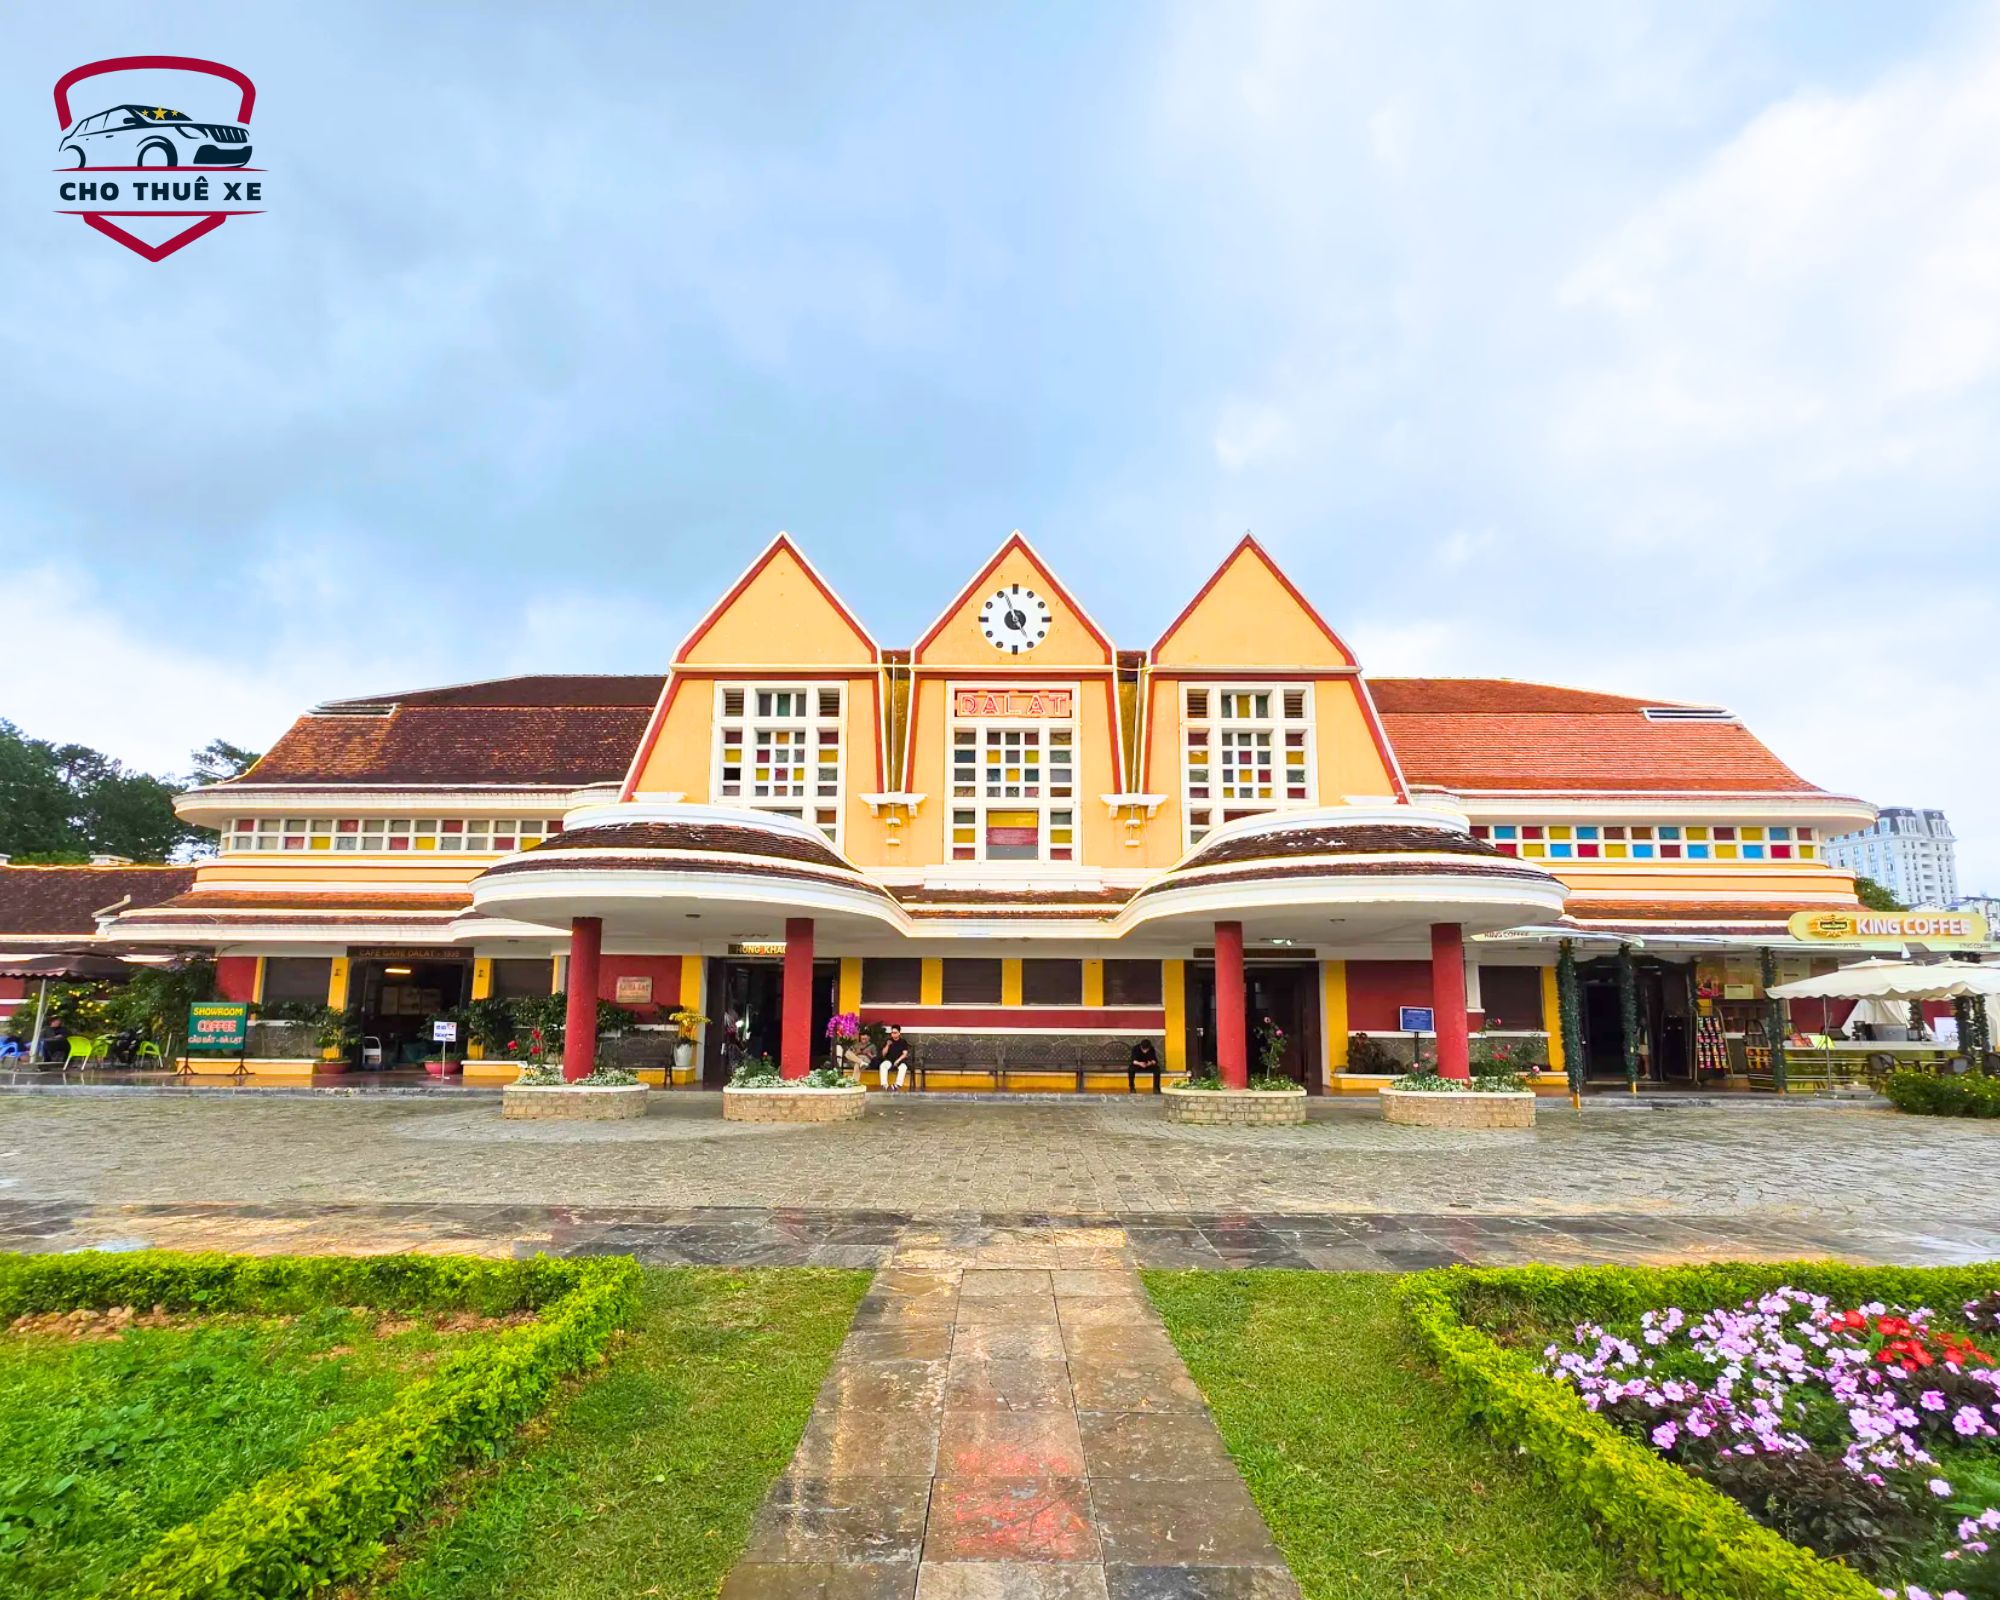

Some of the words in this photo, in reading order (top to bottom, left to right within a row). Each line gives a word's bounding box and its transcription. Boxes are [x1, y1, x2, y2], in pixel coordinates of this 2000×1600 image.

[960, 694, 1068, 715] DALAT
[1856, 918, 1900, 935] KING
[1903, 918, 1972, 935] COFFEE
[193, 1007, 243, 1016] SHOWROOM
[197, 1020, 237, 1032] COFFEE
